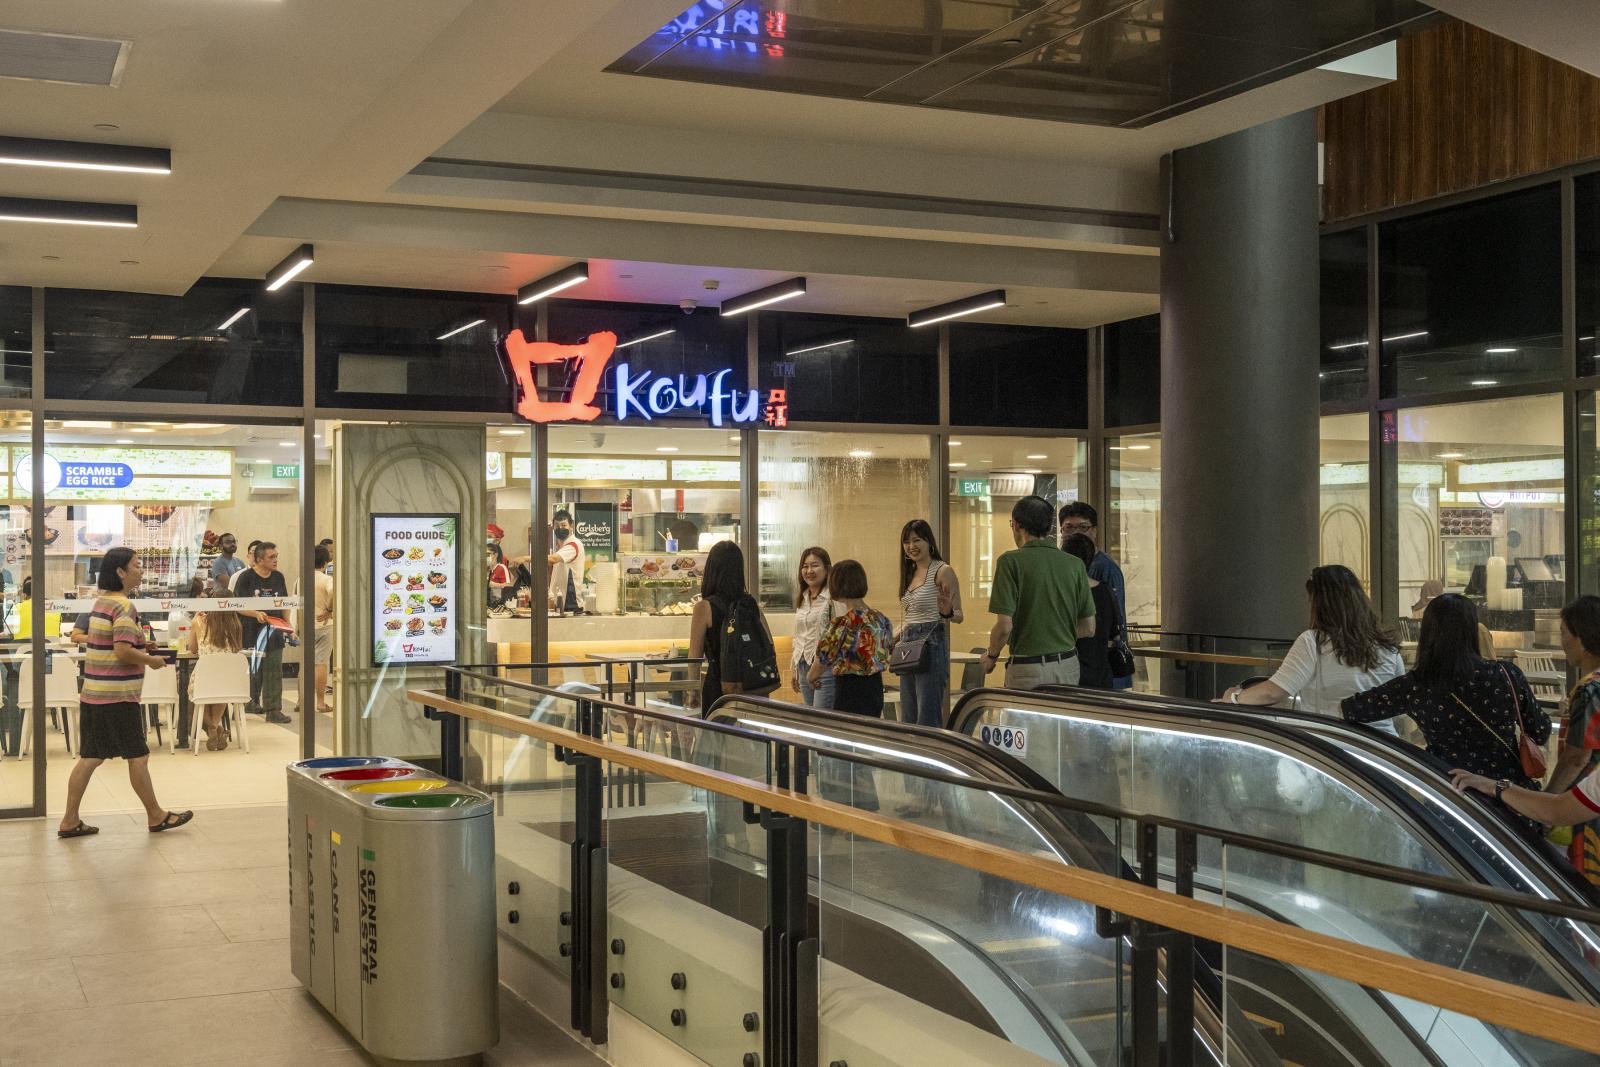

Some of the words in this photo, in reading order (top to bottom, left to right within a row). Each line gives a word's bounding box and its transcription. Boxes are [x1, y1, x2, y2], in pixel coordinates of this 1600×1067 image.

[66, 466, 124, 476] SCRAMBLE
[276, 466, 295, 477] EXIT
[66, 476, 88, 486] EGG
[91, 476, 116, 486] RICE
[964, 482, 983, 493] EXIT
[576, 522, 611, 535] Carlsberg
[385, 531, 412, 540] FOOD
[414, 531, 446, 540] GUIDE
[307, 833, 315, 956] PLASTIC
[331, 849, 340, 933] CANS
[360, 868, 370, 984] WASTE
[366, 869, 378, 985] GENERAL
